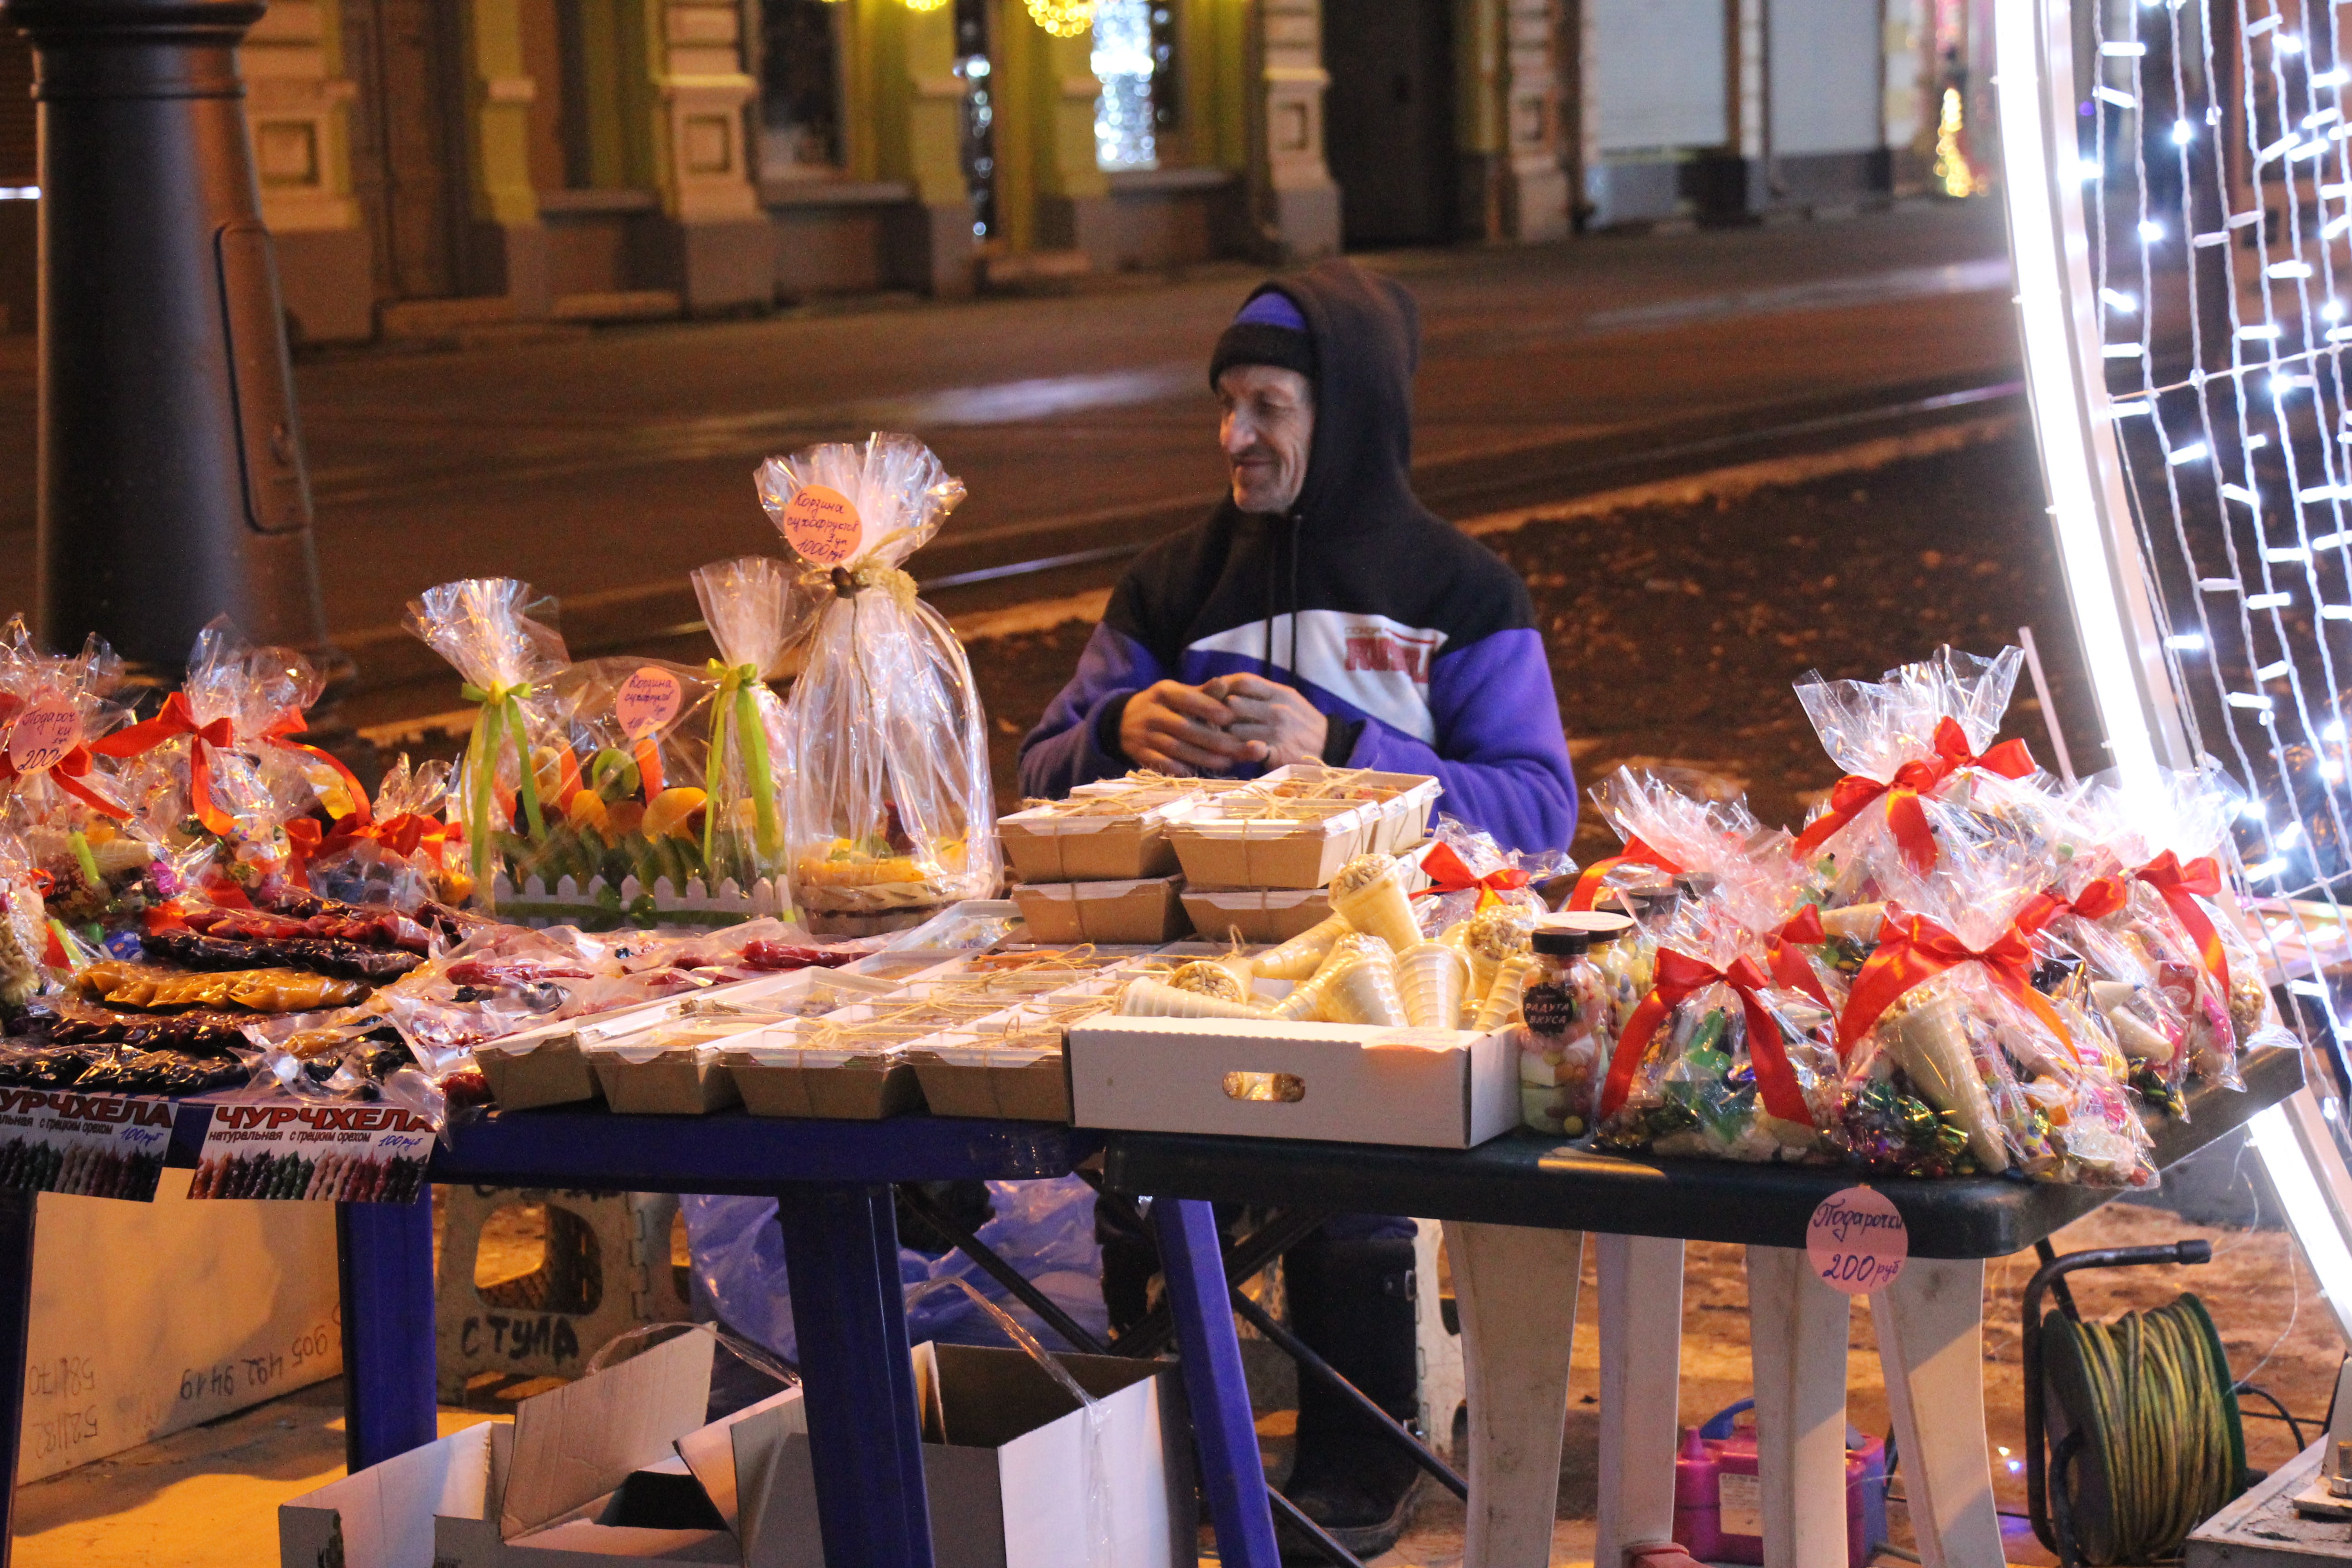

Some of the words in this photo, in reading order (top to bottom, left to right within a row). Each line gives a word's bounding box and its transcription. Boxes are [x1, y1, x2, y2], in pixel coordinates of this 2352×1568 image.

[794, 490, 844, 518] Корзина
[0, 1089, 173, 1128] УРЧХЕЛА
[216, 1107, 437, 1133] ЧУРЧХЕЛА
[207, 1131, 283, 1143] натуральная
[337, 1132, 371, 1144] орехом
[292, 1324, 328, 1368] 905
[461, 1315, 579, 1365] СТУЛА
